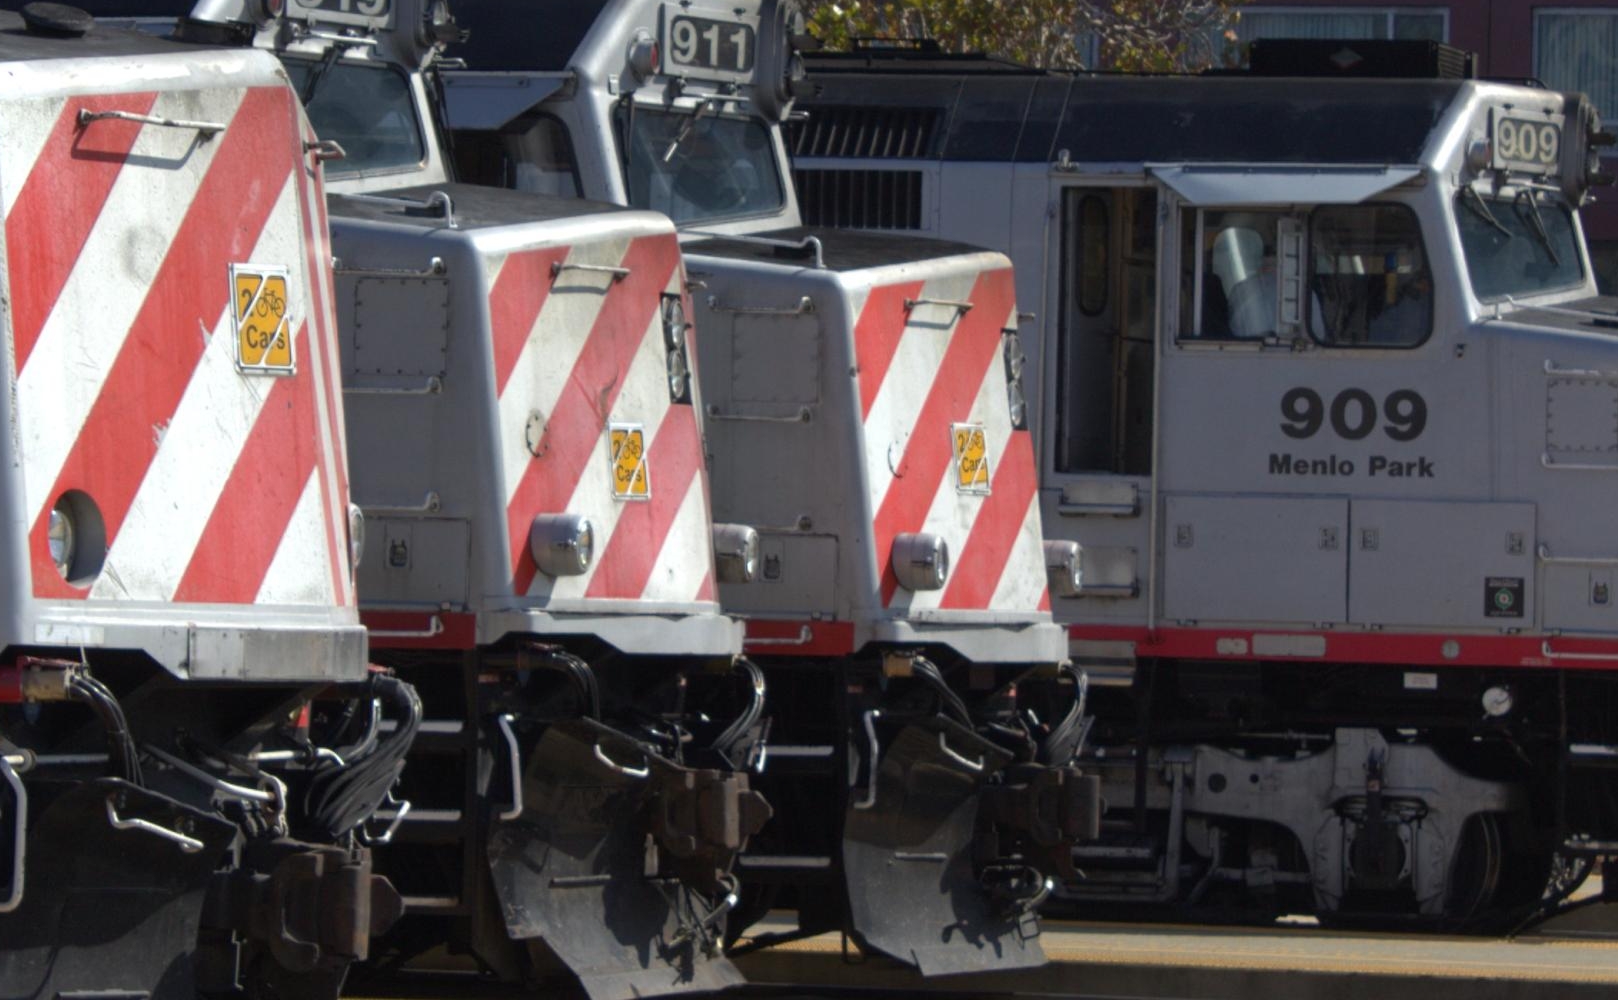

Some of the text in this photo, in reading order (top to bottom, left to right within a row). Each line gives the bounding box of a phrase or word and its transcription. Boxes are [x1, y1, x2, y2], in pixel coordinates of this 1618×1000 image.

[672, 20, 747, 69] 911
[1499, 120, 1558, 163] 909
[241, 288, 253, 317] 2
[1280, 387, 1428, 442] 909
[1269, 453, 1435, 477] Menlo Park
